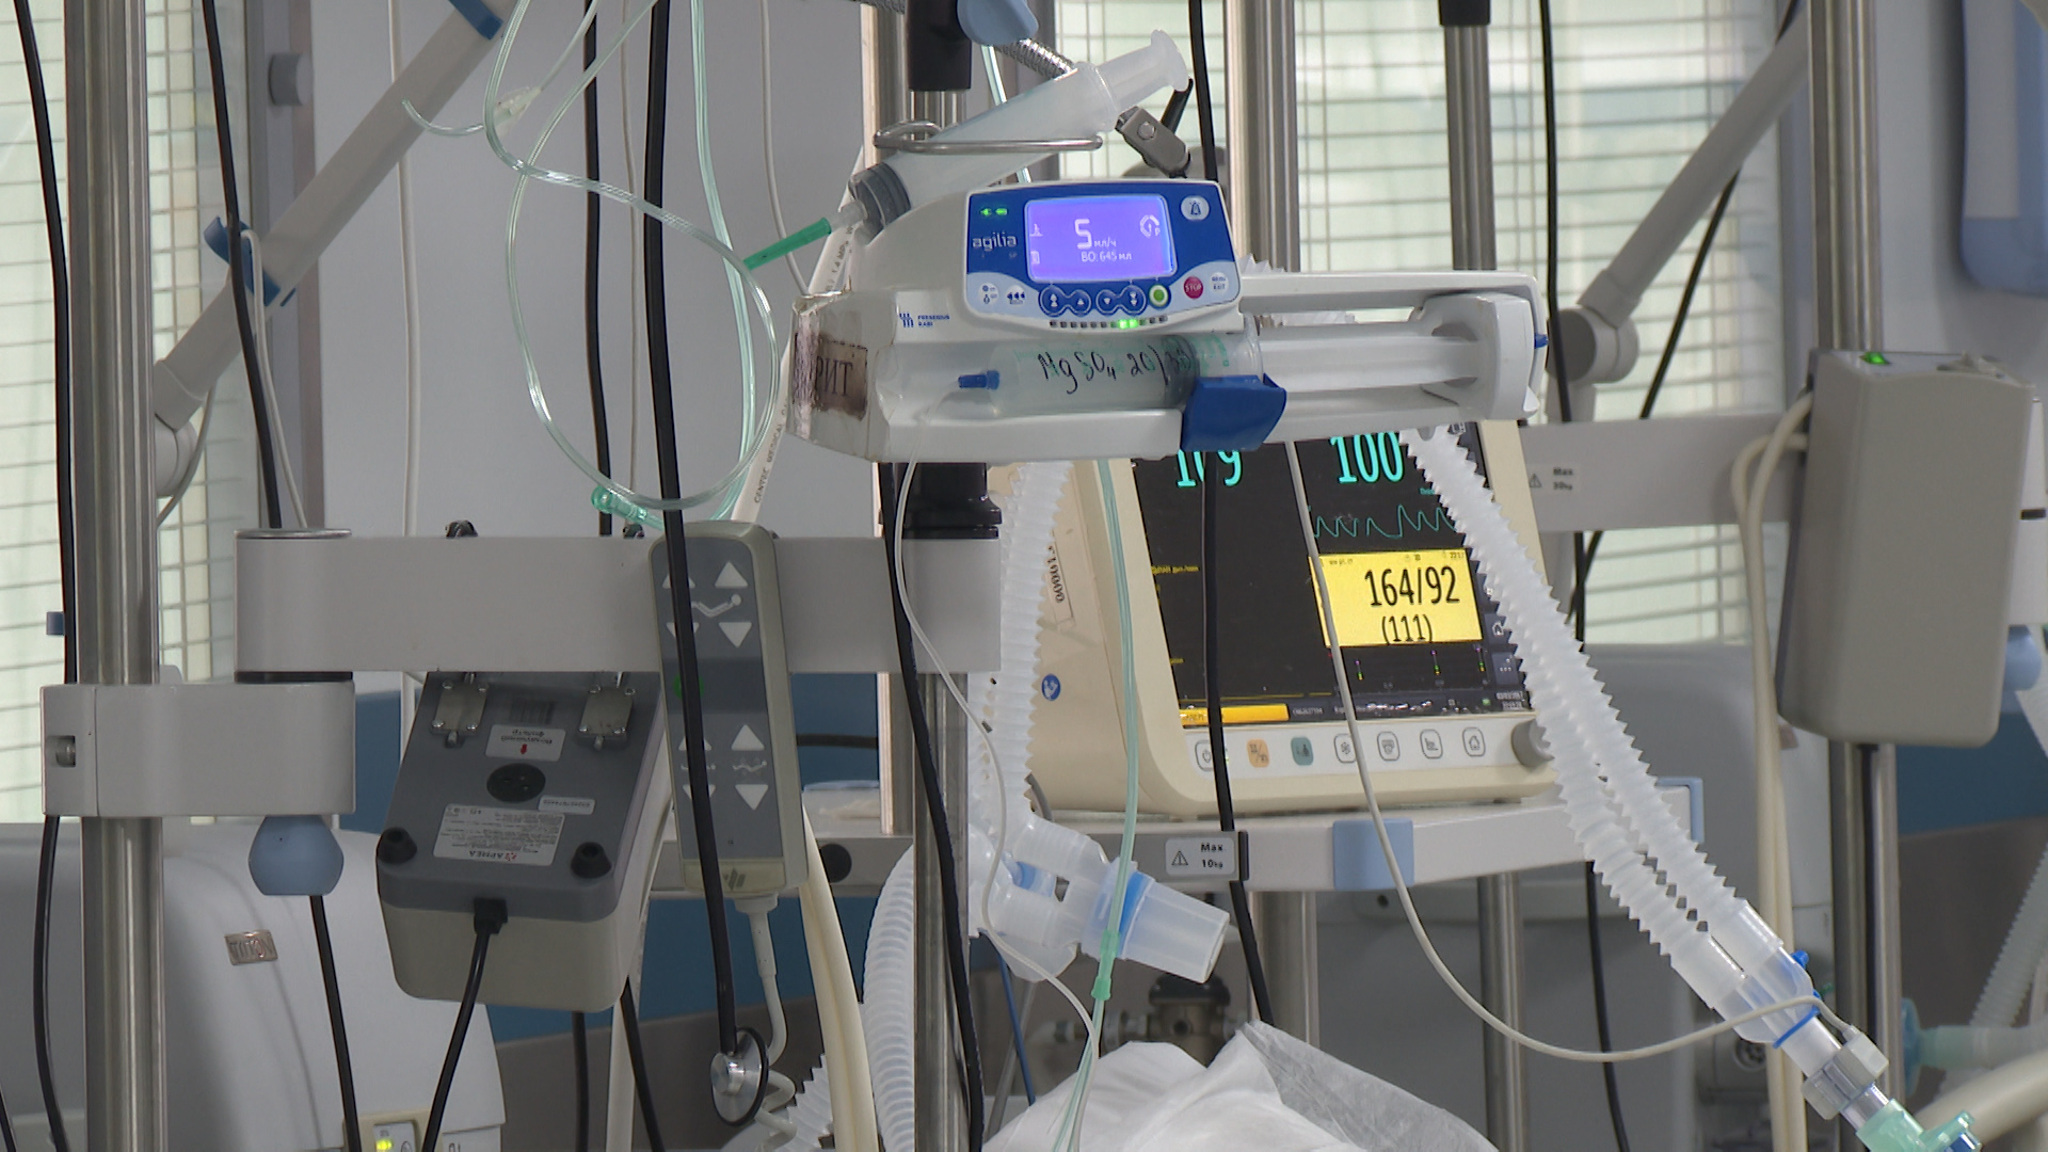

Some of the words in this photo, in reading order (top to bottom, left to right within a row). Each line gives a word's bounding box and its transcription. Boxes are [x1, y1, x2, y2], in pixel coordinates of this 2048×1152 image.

[972, 230, 1017, 252] agilia
[1074, 218, 1093, 249] 5
[1185, 283, 1202, 292] STOP
[1177, 449, 1242, 487] 19
[1330, 432, 1403, 483] 100
[1364, 565, 1460, 607] 164/92
[1381, 613, 1434, 644] (111)
[1200, 842, 1223, 853] Max
